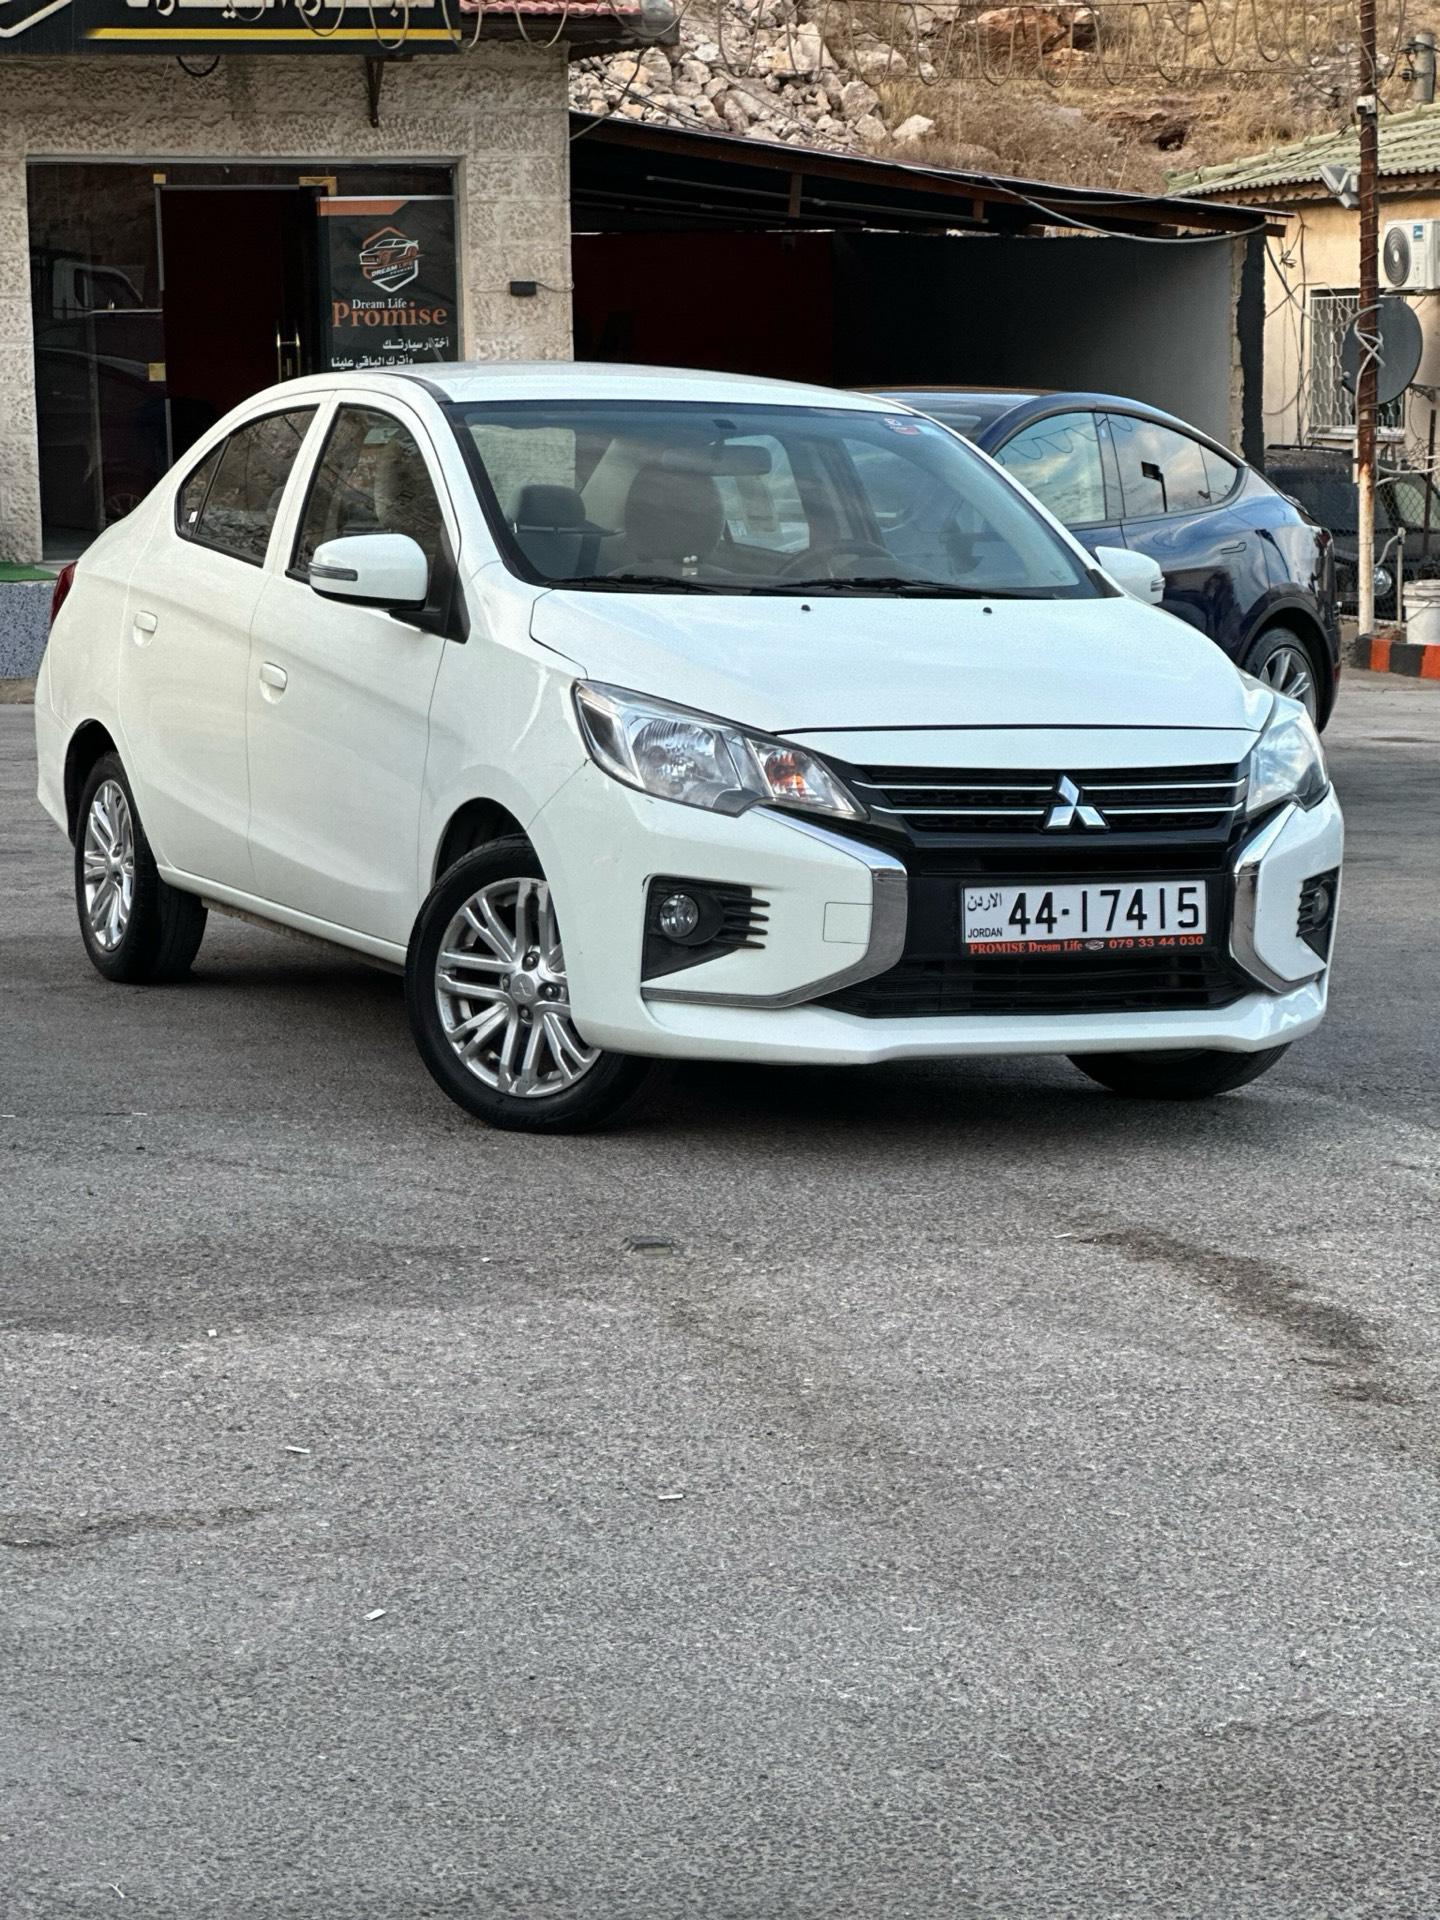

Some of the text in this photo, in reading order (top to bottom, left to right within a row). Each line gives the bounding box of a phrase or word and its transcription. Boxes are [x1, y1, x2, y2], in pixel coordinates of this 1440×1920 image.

[371, 264, 398, 277] DREAM
[352, 298, 407, 309] Dream Life
[332, 301, 447, 327] Promise
[331, 356, 354, 370] علينا
[967, 892, 1002, 911] الاردن
[967, 928, 1003, 939] JORDAN
[969, 936, 1204, 955] PROMISE Dream Life 079 33 44 030
